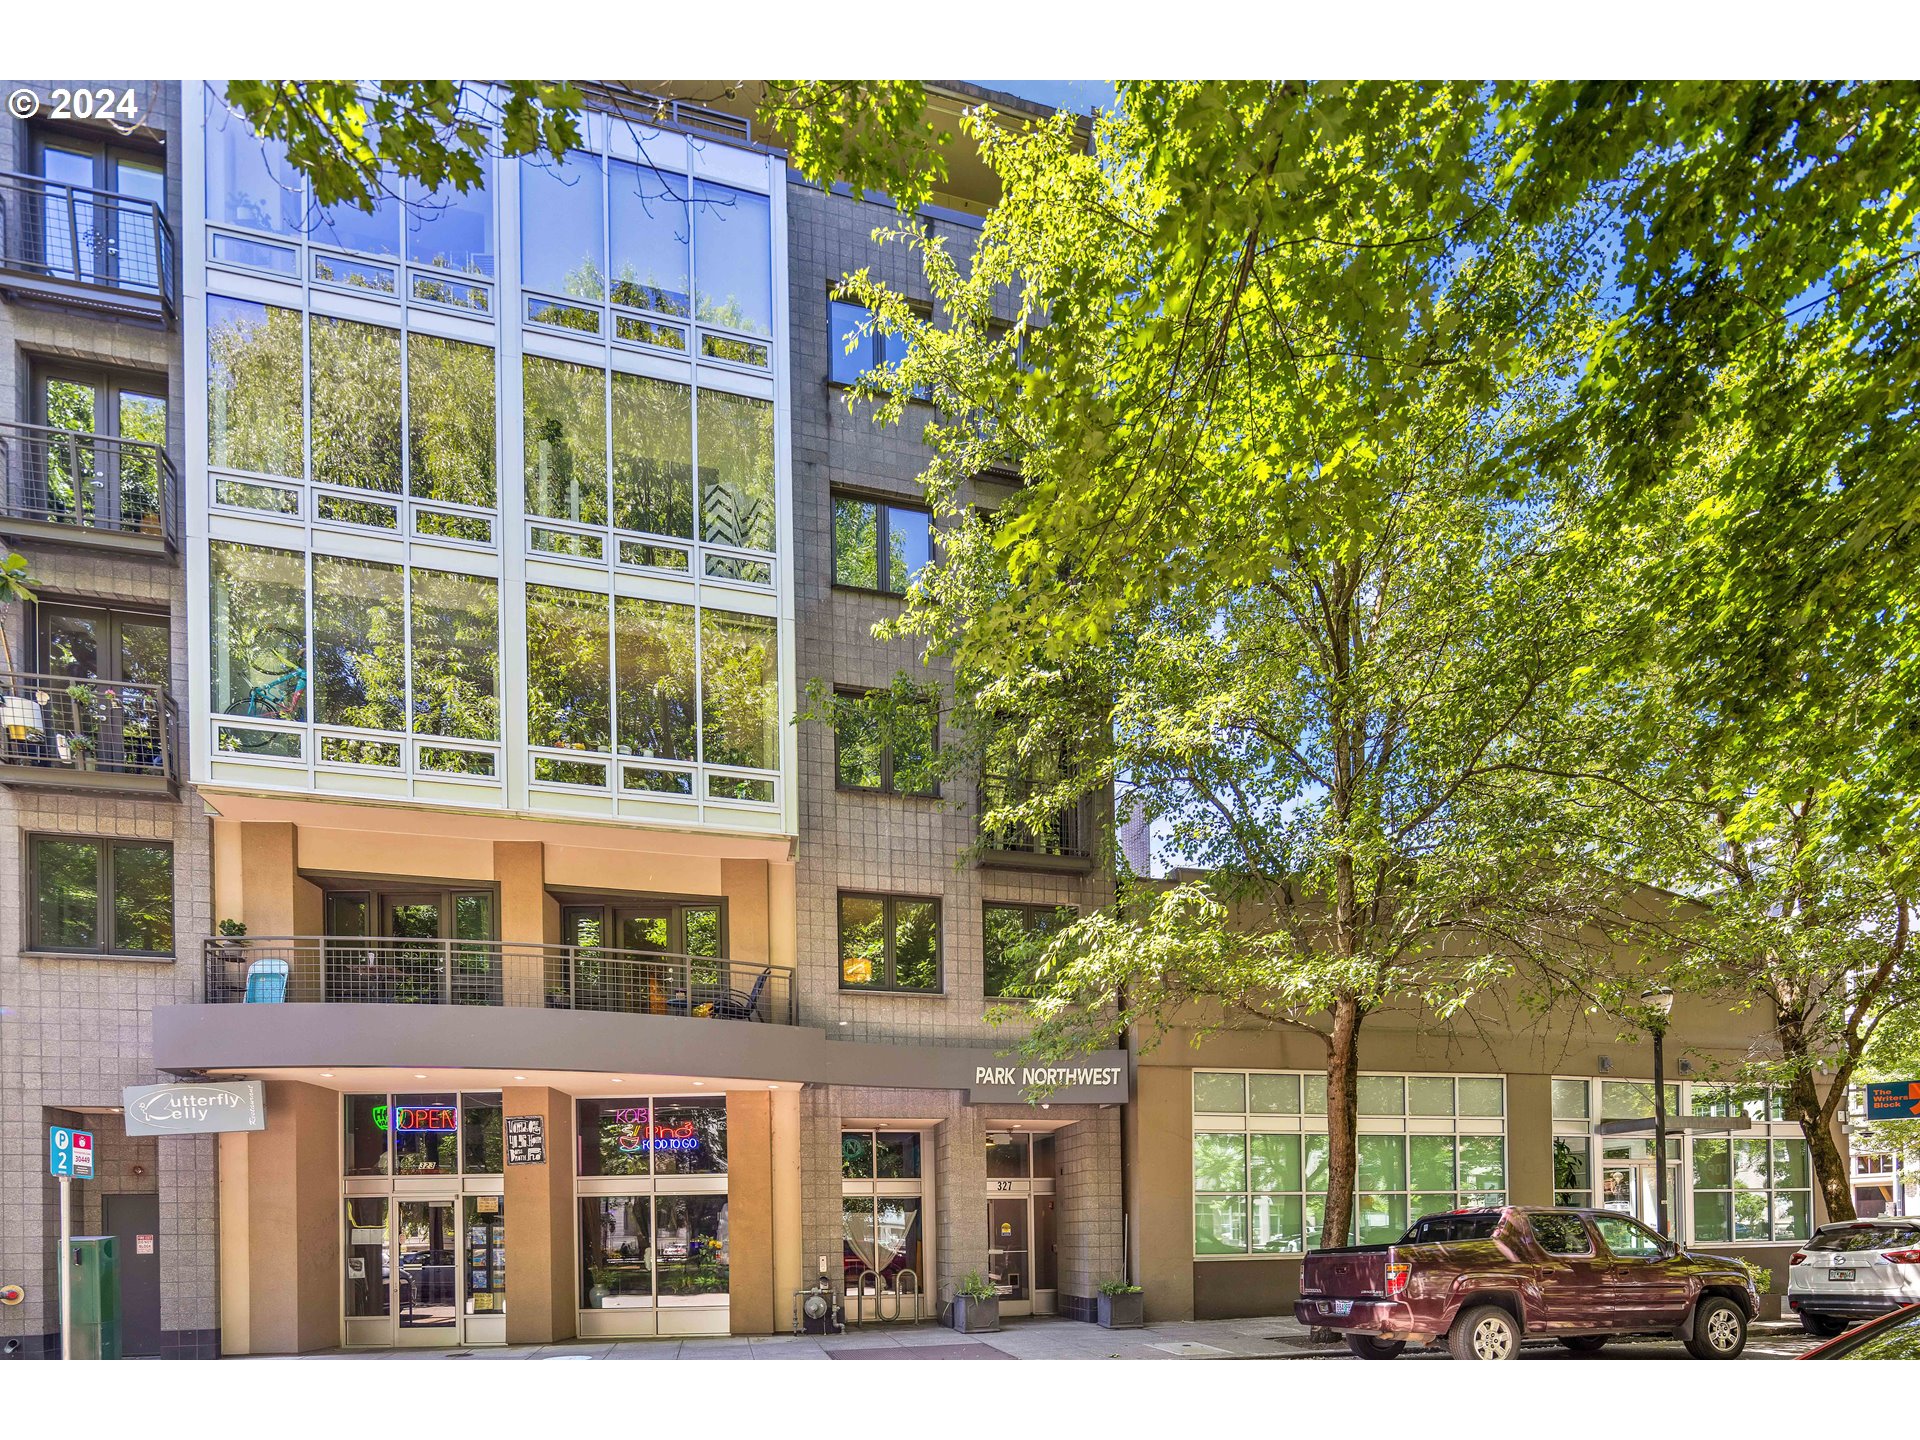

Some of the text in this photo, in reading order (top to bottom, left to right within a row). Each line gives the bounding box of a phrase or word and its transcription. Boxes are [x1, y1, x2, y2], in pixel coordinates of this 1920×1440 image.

[975, 1066, 1121, 1085] PARK NORTHWEST
[1873, 1101, 1901, 1109] Block
[400, 1109, 455, 1129] OPEN
[642, 1138, 697, 1149] FOOD TO GO
[58, 1151, 67, 1170] 2
[75, 1156, 91, 1164] 30449
[997, 1181, 1012, 1191] 327
